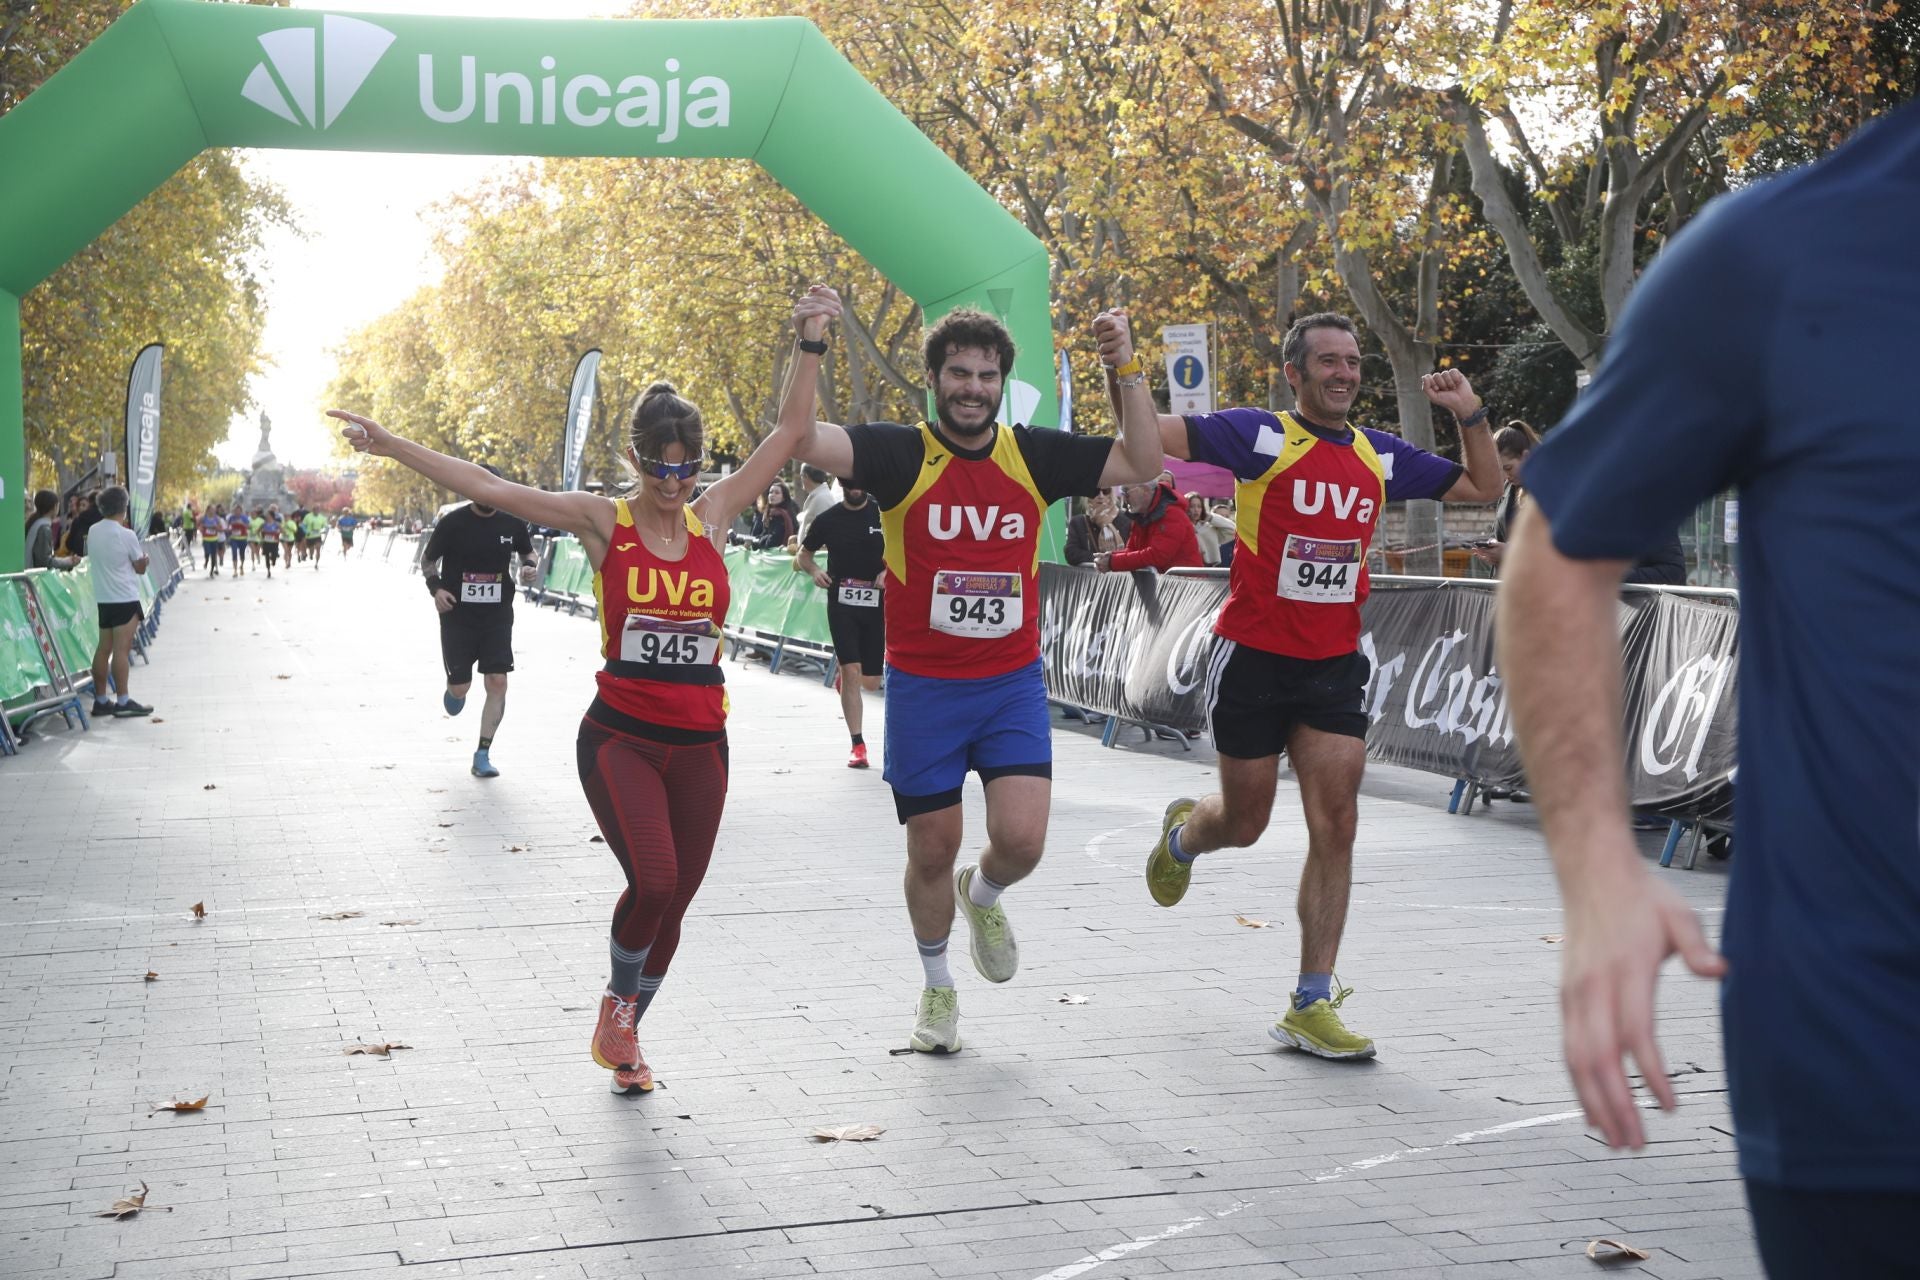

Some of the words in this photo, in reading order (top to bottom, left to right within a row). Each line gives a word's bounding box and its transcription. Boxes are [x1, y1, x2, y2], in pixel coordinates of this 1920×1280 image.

[419, 54, 731, 144] Unicaja
[137, 391, 160, 485] Unicaja
[1292, 479, 1374, 524] UVa
[928, 503, 1025, 541] UVa
[467, 585, 495, 597] 511
[627, 567, 714, 608] UVa
[965, 581, 998, 591] EMPRESAS
[1297, 562, 1348, 590] 944
[844, 588, 873, 601] 512
[679, 609, 713, 619] Valladolid
[949, 596, 1005, 625] 943
[641, 633, 699, 664] 945
